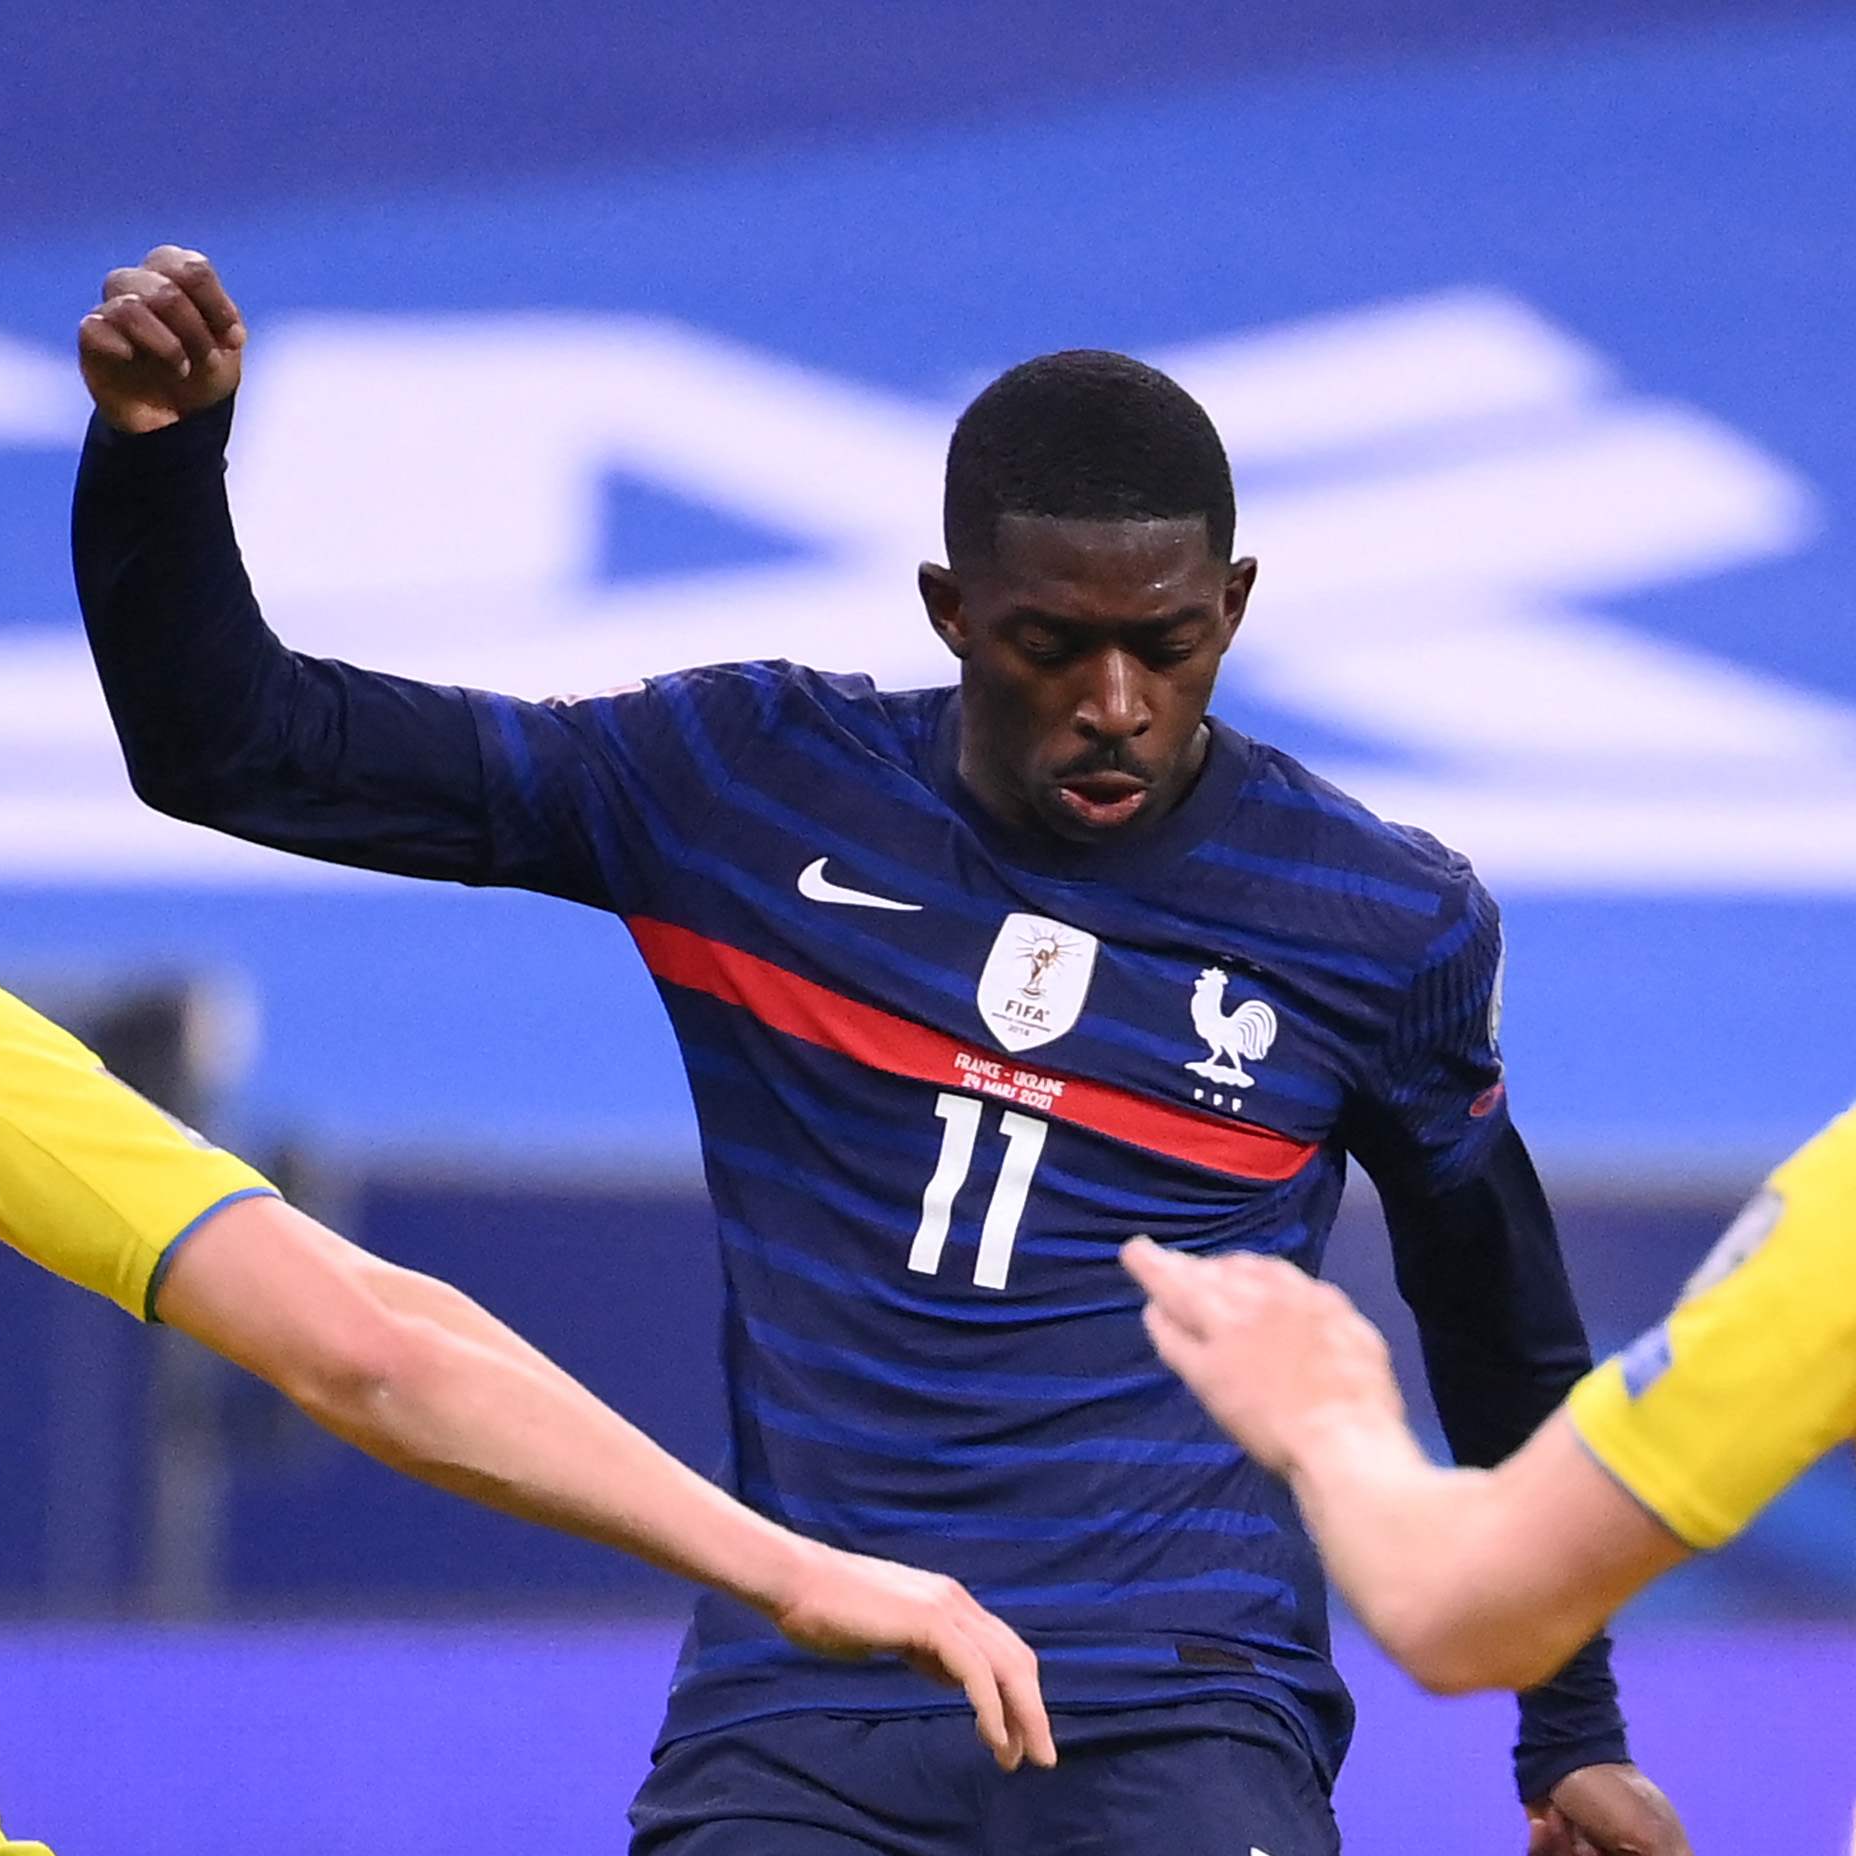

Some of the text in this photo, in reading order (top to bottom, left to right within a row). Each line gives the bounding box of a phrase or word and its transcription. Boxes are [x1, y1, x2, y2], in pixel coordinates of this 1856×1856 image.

[1004, 999, 1045, 1023] FIFA
[953, 1052, 1003, 1080] FRANCE
[1012, 1069, 1067, 1097] UKRAINE
[982, 1079, 1018, 1099] MARS
[1017, 1088, 1054, 1111] 2021
[907, 1091, 1050, 1291] 11
